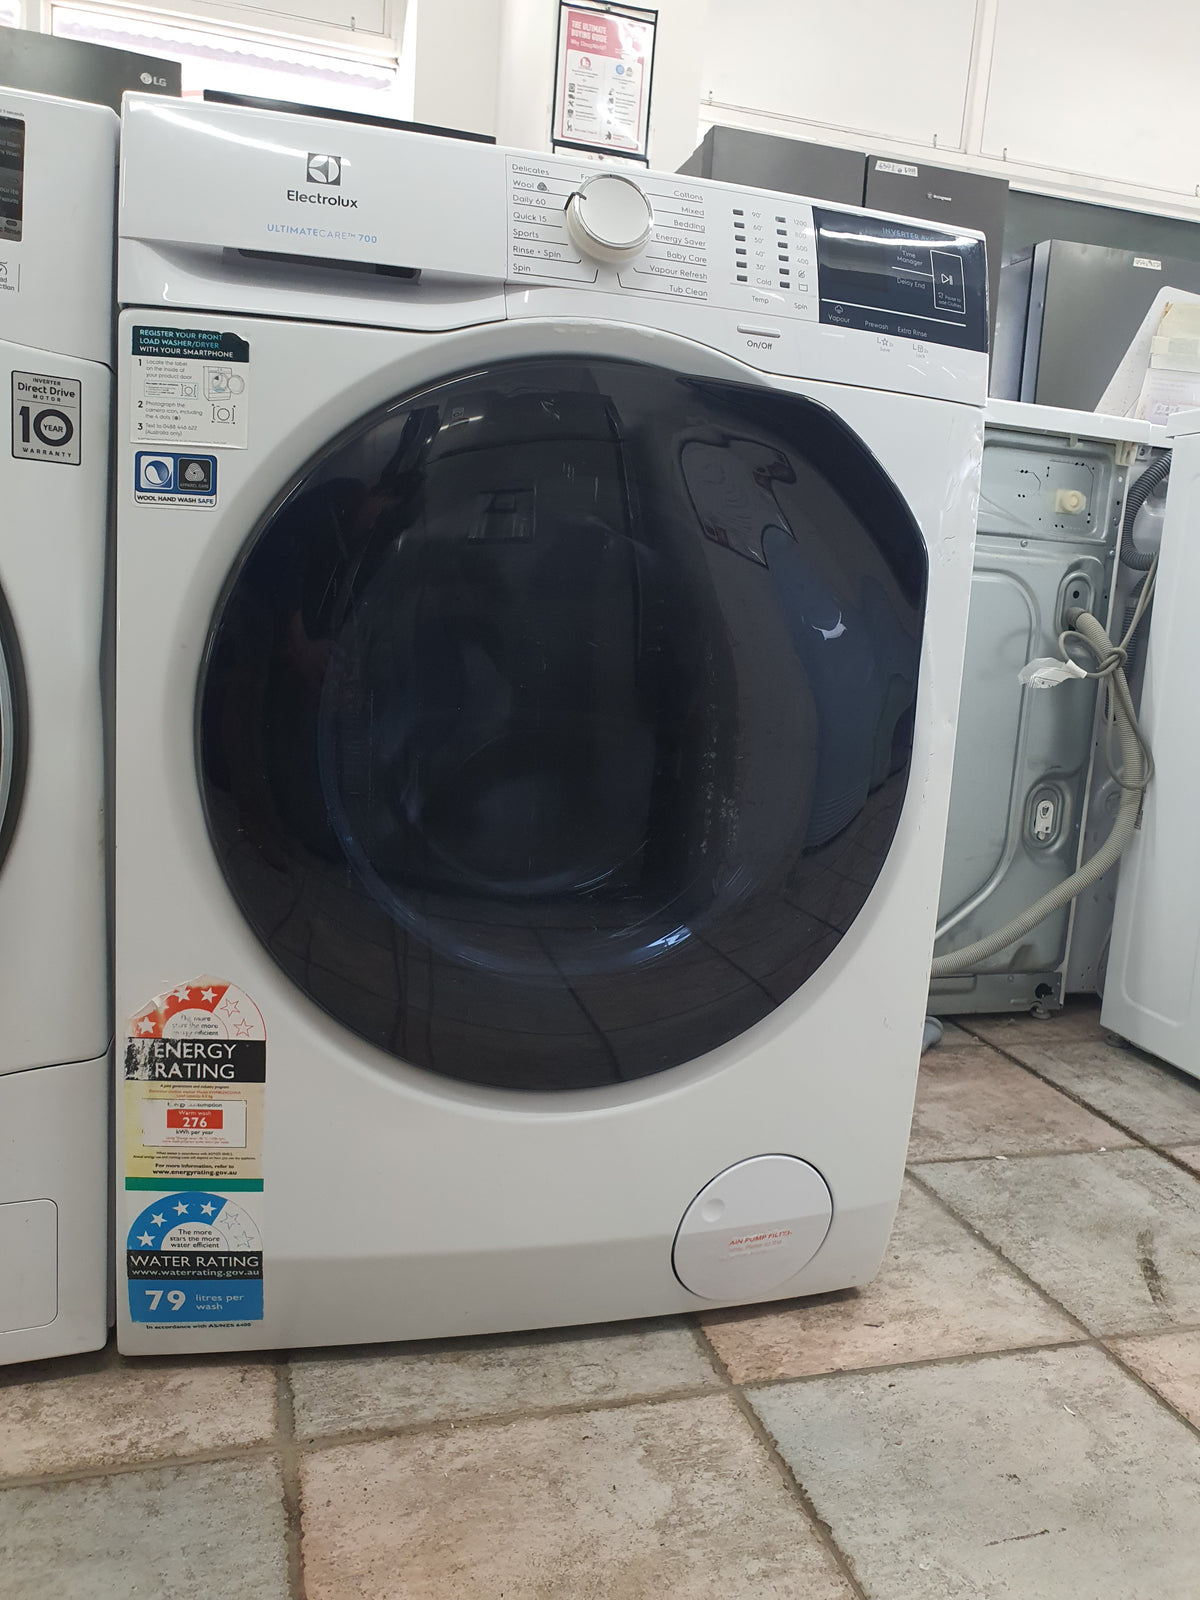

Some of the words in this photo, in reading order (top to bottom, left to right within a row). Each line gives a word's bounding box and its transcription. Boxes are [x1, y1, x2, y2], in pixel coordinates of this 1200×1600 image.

[571, 20, 582, 29] THE
[582, 23, 607, 34] ULTIMATE
[153, 76, 167, 86] LG
[512, 164, 549, 175] Delicates
[513, 180, 534, 188] Wool
[287, 190, 358, 208] Electrolux
[513, 195, 533, 204] Daily
[674, 191, 703, 201] Cottons
[513, 212, 536, 220] Quick
[682, 206, 704, 216] Mixed
[674, 220, 705, 231] Bedding
[794, 219, 807, 227] 1200
[358, 234, 377, 243] 700
[513, 229, 539, 238] Sports
[882, 227, 919, 240] INVERTER
[656, 233, 682, 244] Energy
[684, 237, 706, 246] Saver
[513, 246, 534, 254] Rinse
[544, 250, 561, 258] Spin
[667, 251, 686, 261] Baby
[689, 254, 707, 263] Care
[902, 250, 916, 258] Time
[897, 256, 923, 266] Manager
[513, 264, 530, 272] Spin
[650, 265, 677, 276] Vapour
[680, 270, 707, 280] Refresh
[757, 278, 771, 286] Cold
[897, 278, 913, 288] Delay
[915, 282, 925, 290] End
[670, 285, 683, 293] Tub
[685, 288, 708, 296] Clean
[752, 296, 769, 304] Temp
[828, 314, 850, 324] Vapour
[865, 320, 888, 330] Prewash
[140, 329, 174, 338] REGISTER
[175, 331, 196, 339] YOUR
[897, 327, 912, 335] Extra
[913, 328, 927, 338] Rinse
[161, 339, 219, 348] WASHER/DRYER
[747, 340, 772, 350] On/Off
[183, 349, 233, 358] SMARTPHONE
[33, 378, 61, 386] INVERTER
[18, 382, 47, 394] Direct
[50, 387, 75, 398] Drive
[33, 394, 61, 402] MOTOR
[19, 406, 73, 446] 10
[43, 424, 63, 432] YEAR
[23, 447, 71, 458] WARRANTY
[154, 1043, 237, 1059] ENERGY
[155, 1062, 235, 1079] RATING
[182, 1117, 207, 1128] 276
[744, 1235, 767, 1243] PUMP
[130, 1256, 190, 1267] WATER
[196, 1256, 258, 1267] RATING
[132, 1269, 259, 1277] www.waterrating.gov.au
[145, 1290, 186, 1311] 79
